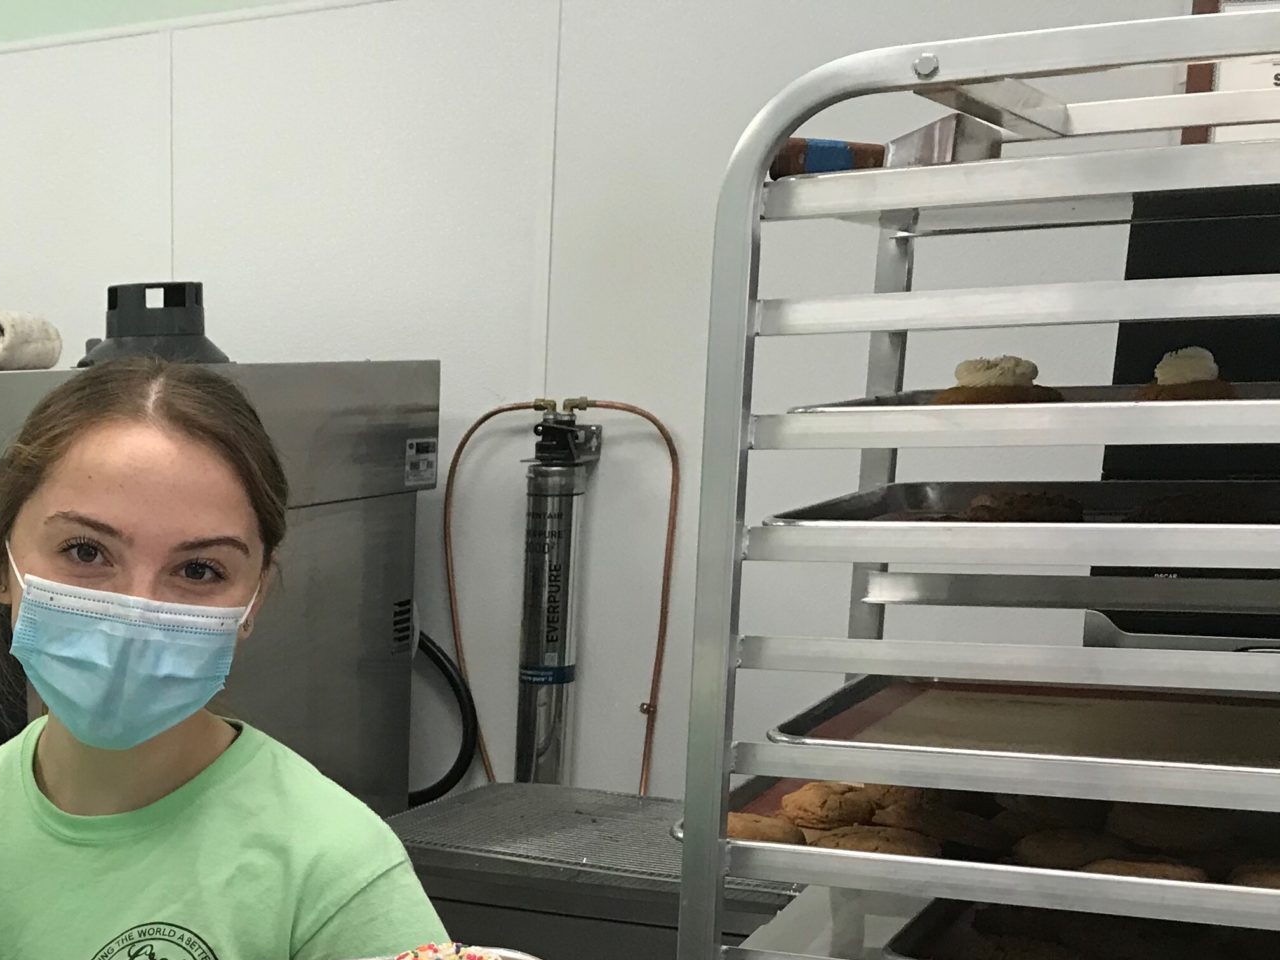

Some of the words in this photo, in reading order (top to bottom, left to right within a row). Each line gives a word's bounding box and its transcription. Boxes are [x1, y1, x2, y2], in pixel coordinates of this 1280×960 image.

[546, 561, 561, 643] EVERPURE
[115, 932, 135, 947] THE
[137, 927, 176, 938] WORLD
[177, 934, 185, 942] A
